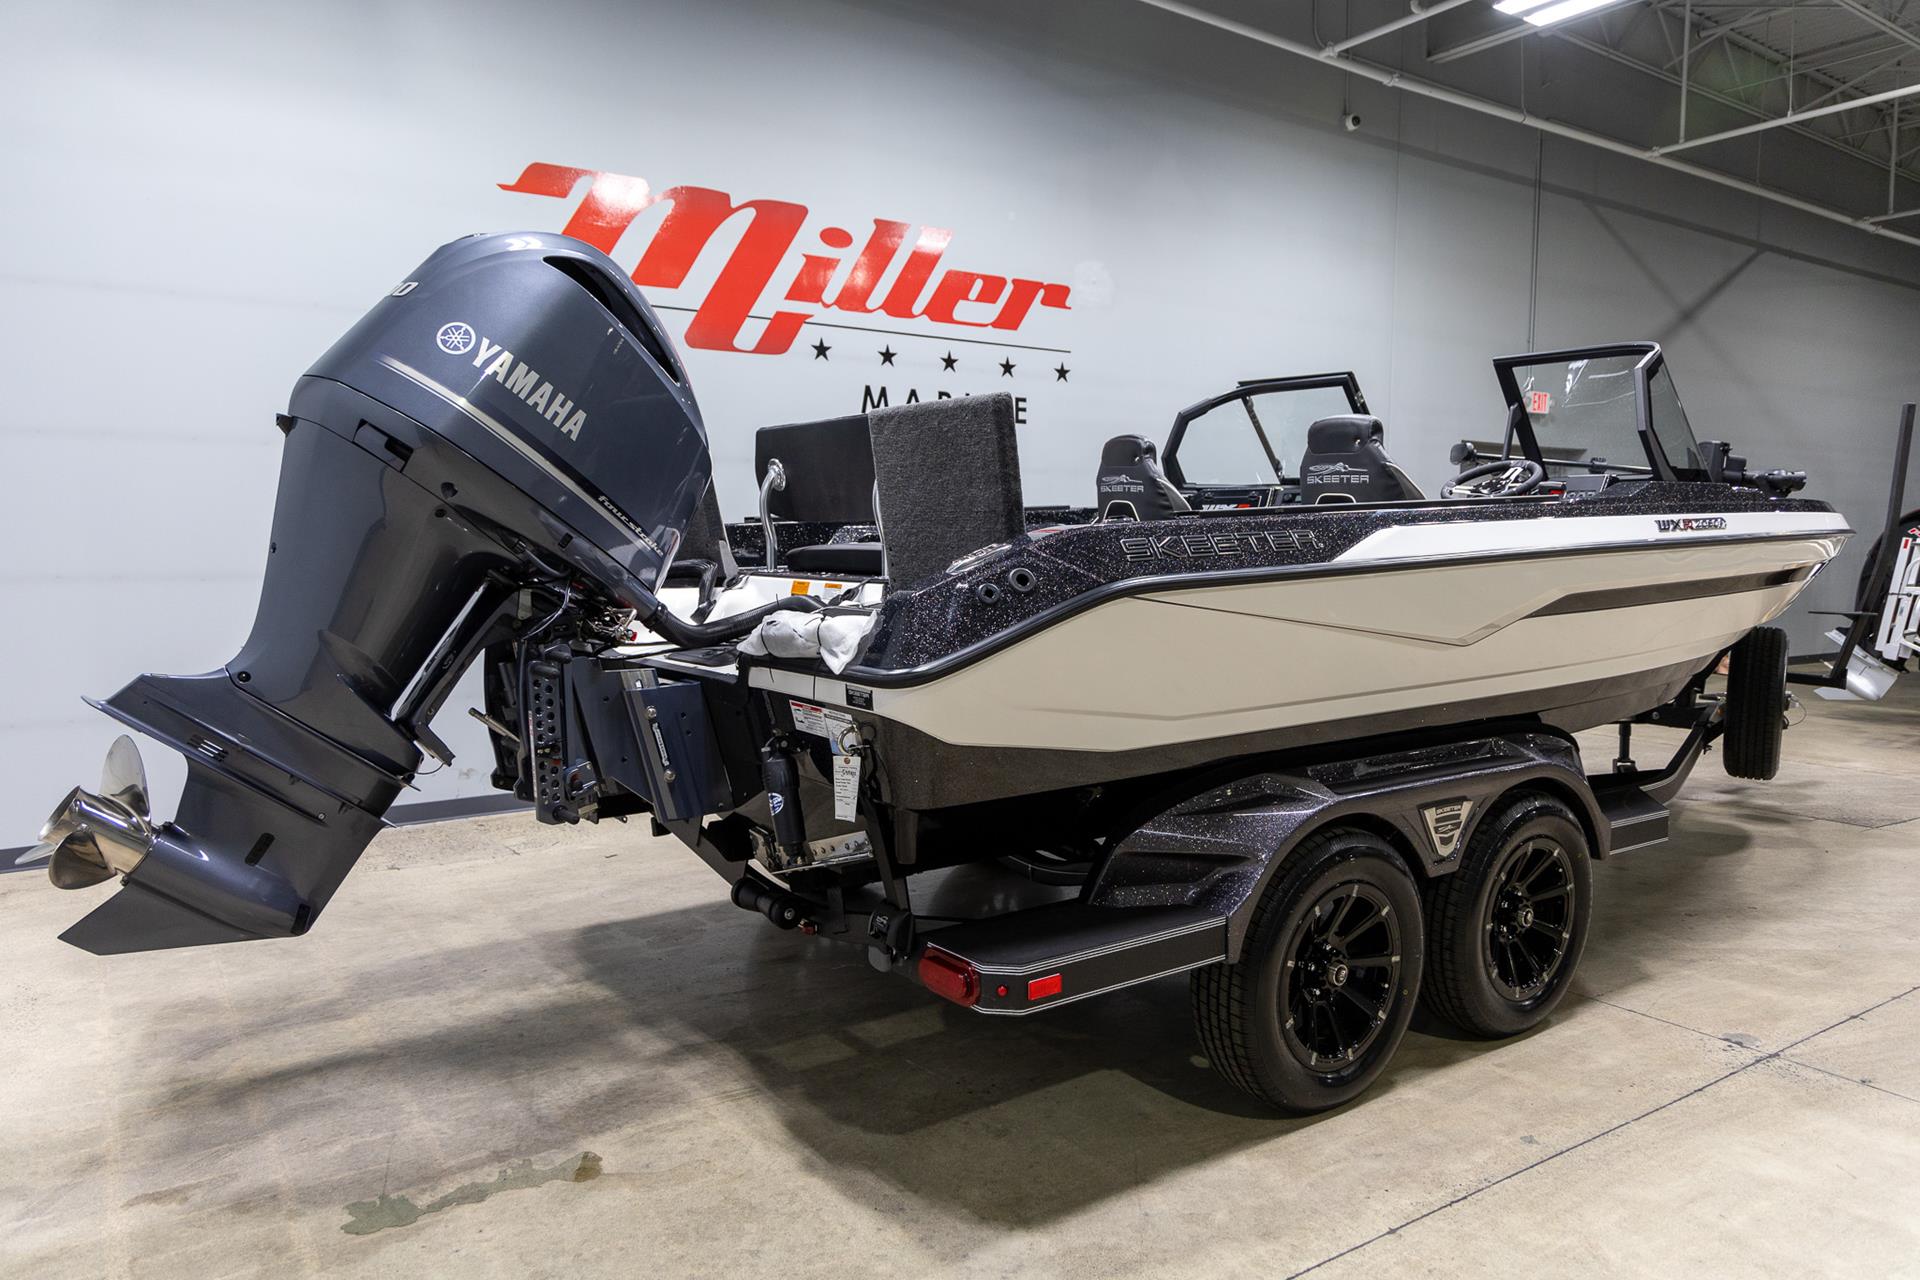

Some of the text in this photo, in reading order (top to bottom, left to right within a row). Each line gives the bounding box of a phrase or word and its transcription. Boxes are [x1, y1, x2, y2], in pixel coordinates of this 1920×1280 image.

[497, 162, 1072, 354] Miller
[471, 336, 588, 442] YAMAHA
[1100, 485, 1145, 493] SKEETER
[1307, 474, 1370, 485] SKEETER
[1120, 529, 1321, 562] SKEETER
